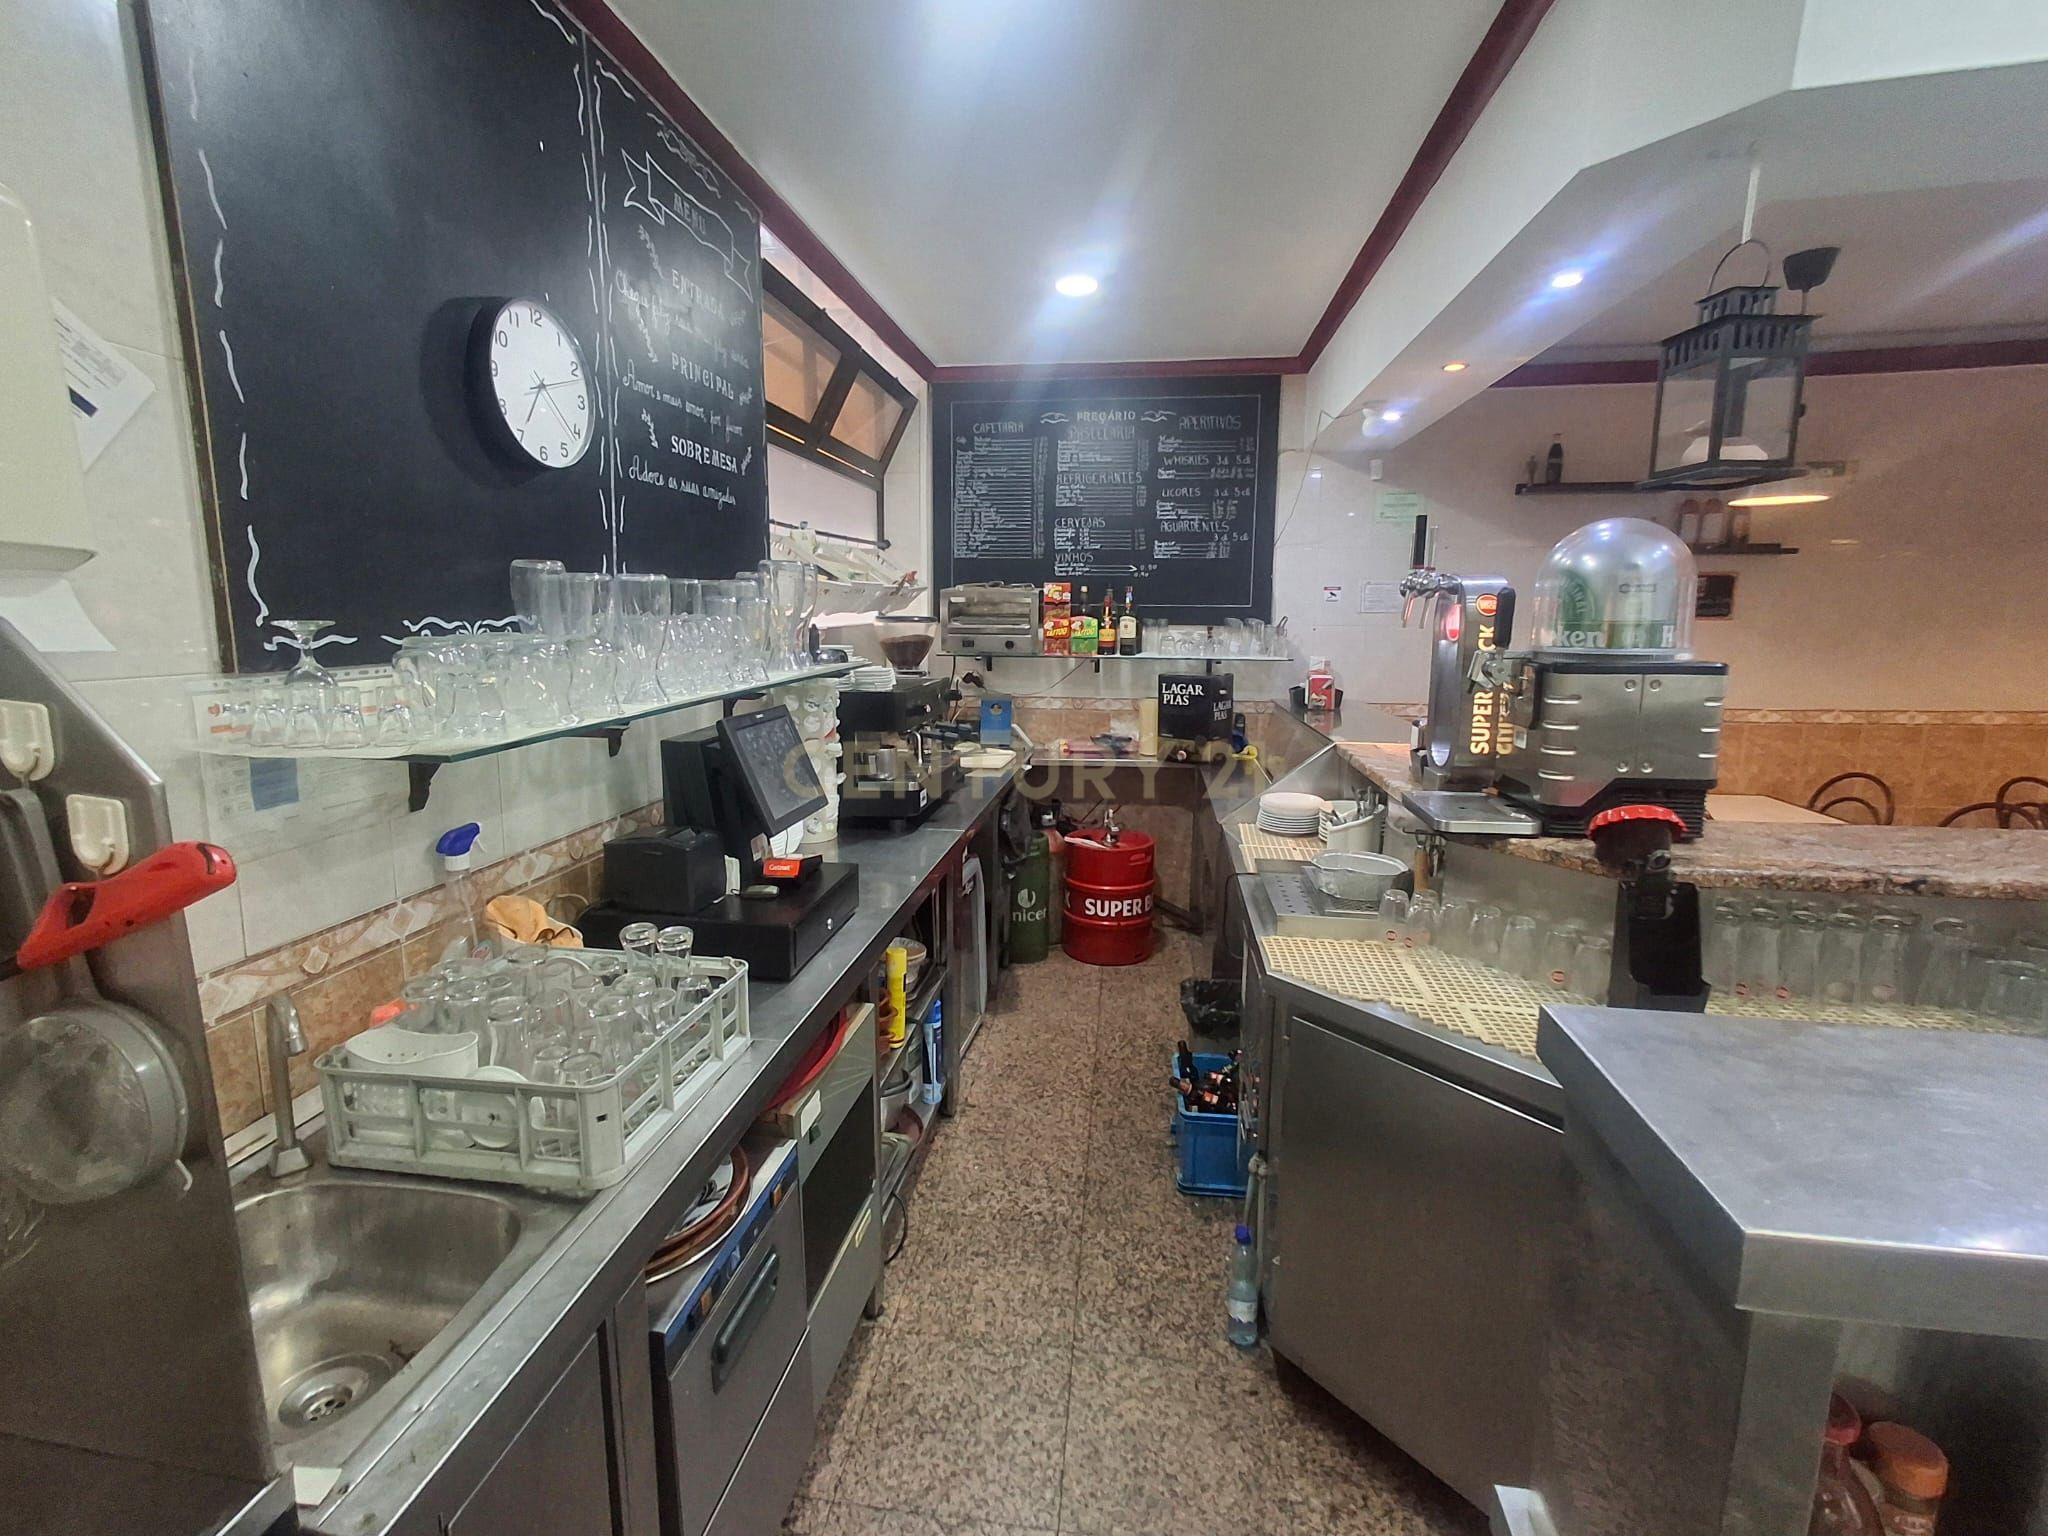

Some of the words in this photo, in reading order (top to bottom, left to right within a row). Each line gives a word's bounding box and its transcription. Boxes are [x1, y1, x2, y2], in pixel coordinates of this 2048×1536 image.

[673, 193, 706, 235] MENU
[528, 307, 543, 327] 12
[494, 329, 508, 348] 10
[570, 361, 579, 377] 2
[671, 352, 734, 400] PRINCIPAL
[577, 394, 586, 411] 3
[516, 428, 525, 443] 7
[573, 423, 581, 440] 4
[539, 446, 549, 461] 6
[560, 442, 569, 458] 5
[671, 434, 738, 474] SOBREMESA
[1163, 454, 1209, 466] WHISKIES
[1162, 487, 1201, 498] LICORES
[1054, 516, 1106, 529] CERVEJAS
[1160, 520, 1230, 533] AGUARDENTES
[1055, 551, 1094, 563] VINHOS
[1161, 683, 1205, 696] LAGAR
[1163, 694, 1190, 706] PIAS
[1470, 690, 1494, 755] SUPER
[1084, 898, 1142, 918] SUPER
